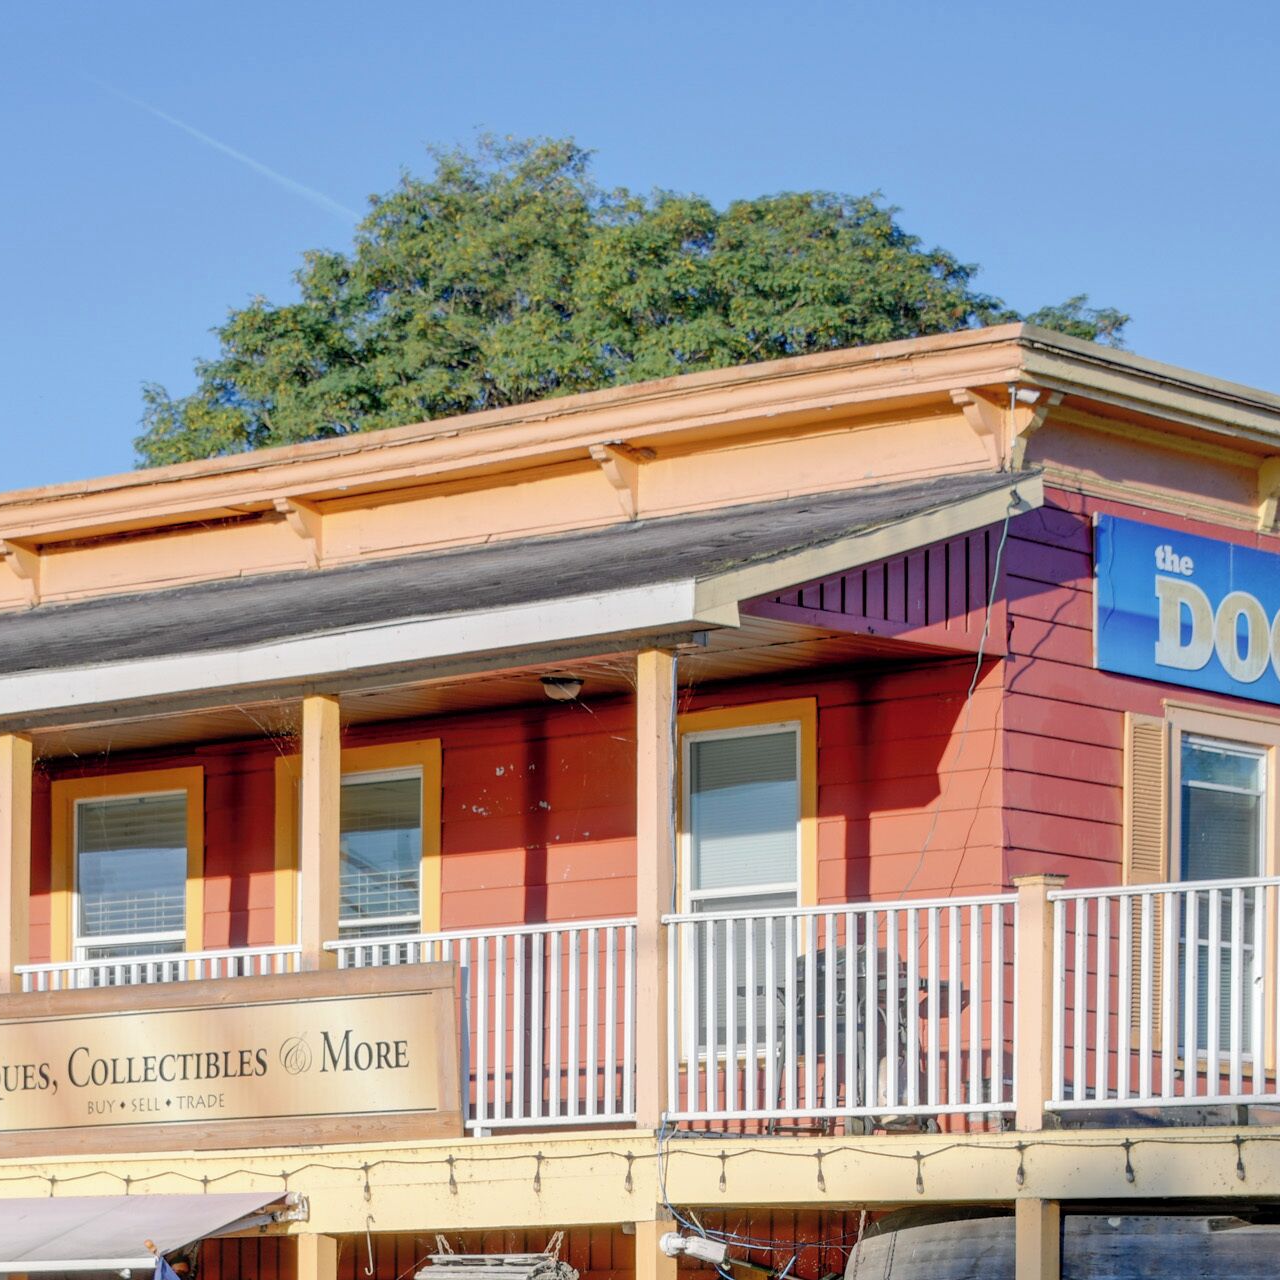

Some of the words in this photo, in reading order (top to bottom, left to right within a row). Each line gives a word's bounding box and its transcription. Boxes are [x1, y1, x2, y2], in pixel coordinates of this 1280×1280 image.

[1154, 544, 1195, 577] the
[67, 1046, 269, 1088] COLLECTIBLES
[278, 1032, 313, 1076] &
[319, 1029, 410, 1073] MORE
[86, 1099, 116, 1115] BUY
[130, 1096, 161, 1113] SELL
[175, 1093, 225, 1110] TRADE
